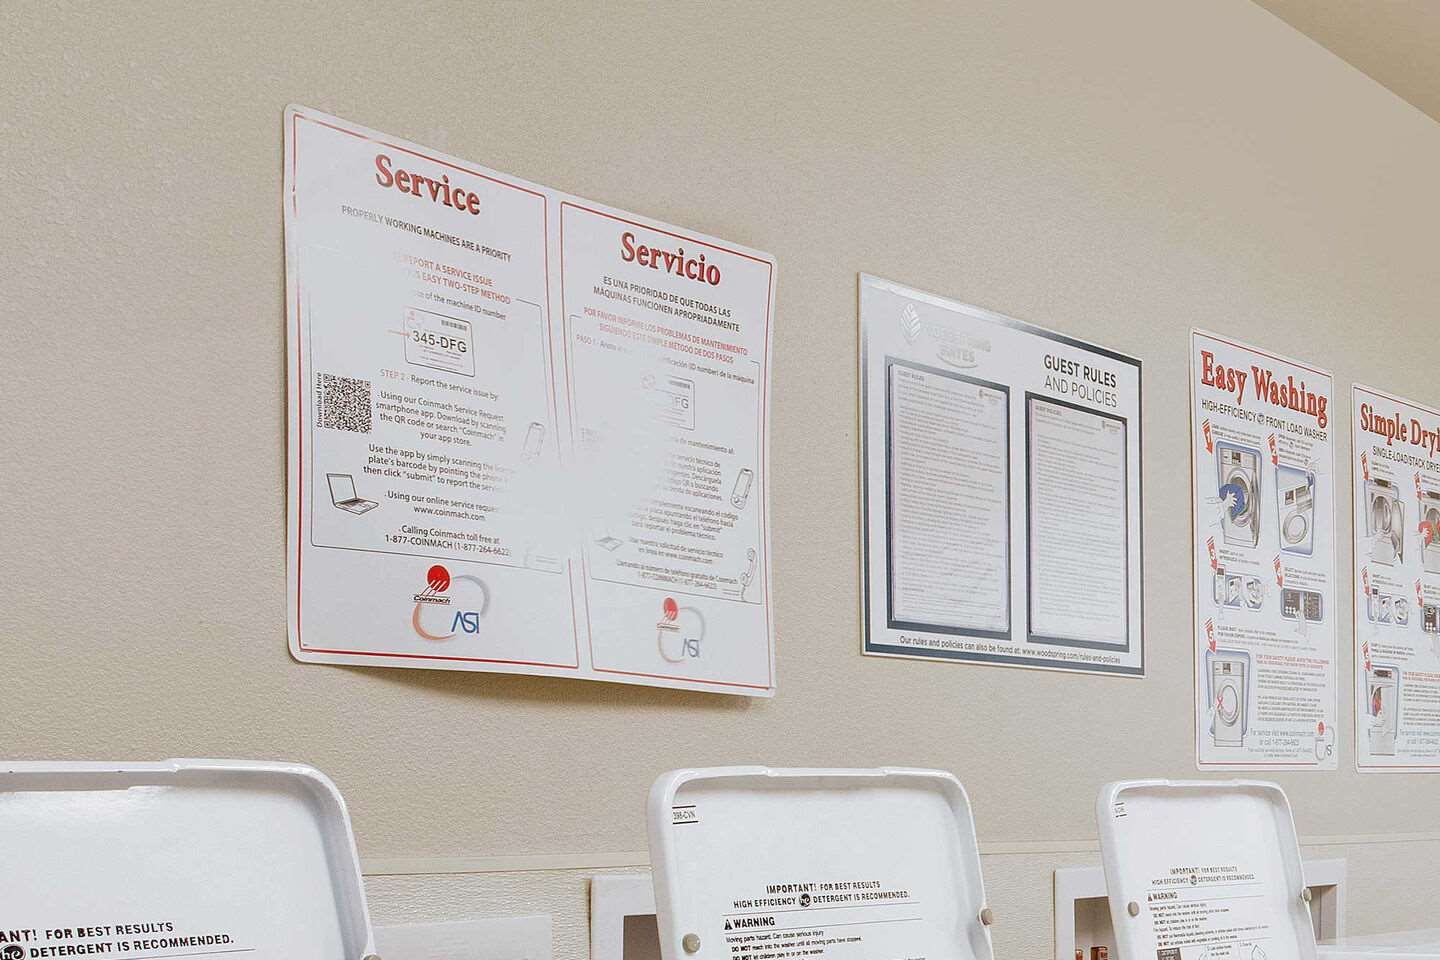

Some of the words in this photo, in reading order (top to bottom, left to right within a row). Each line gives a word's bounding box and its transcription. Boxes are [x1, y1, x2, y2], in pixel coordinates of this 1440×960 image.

[375, 154, 480, 215] Service
[342, 205, 383, 224] PROPERLY
[385, 217, 422, 235] WORKING
[423, 228, 460, 246] MACHINES
[461, 240, 474, 250] ARE
[481, 246, 511, 263] PRIORITY
[621, 232, 720, 286] Servicio
[435, 263, 441, 271] A
[442, 263, 472, 281] SERVICE
[473, 274, 493, 286] ISSUE
[422, 272, 441, 285] EASY
[443, 278, 479, 295] TWO-STEP
[481, 290, 511, 304] METHOD
[604, 276, 612, 284] ES
[613, 280, 628, 289] UNA
[630, 283, 668, 300] PRIORIDAD
[669, 295, 679, 303] DE
[680, 297, 694, 308] QUE
[695, 301, 717, 315] TODAS
[718, 308, 731, 317] LAS
[593, 286, 631, 304] MAQUINAS
[633, 297, 673, 315] FUNCIONEN
[674, 309, 740, 332] APROPRIADAMENTE
[412, 330, 467, 353] 345-DFG
[411, 375, 435, 386] Report
[1044, 354, 1080, 377] GUEST
[1084, 363, 1116, 388] RULES
[380, 391, 402, 403] Using
[418, 397, 452, 410] Coinmach
[1045, 375, 1068, 394] AND
[1071, 381, 1117, 408] POLICIES
[1201, 351, 1247, 405] Easy
[1251, 365, 1327, 429] Washing
[376, 402, 419, 416] smartphone
[1202, 400, 1257, 422] HIGH-EFFICIENCY
[1265, 416, 1285, 431] FRONT
[1287, 422, 1303, 435] LOAD
[1304, 426, 1327, 441] WASHER
[1361, 403, 1407, 445] Simple
[369, 444, 384, 453] Use
[364, 466, 382, 475] then
[384, 469, 400, 477] click
[369, 455, 394, 466] plate's
[396, 460, 427, 471] barcode
[439, 467, 469, 479] pointing
[388, 490, 409, 502] Using
[426, 496, 449, 505] online
[414, 506, 485, 521] www.coinmach.com
[385, 534, 452, 549] 1-877-COINMACH
[402, 525, 428, 537] Calling
[430, 529, 465, 540] Coinmach
[452, 611, 479, 634] ASI
[900, 636, 911, 644] Our
[913, 638, 927, 646] rules
[929, 639, 940, 648] and
[942, 640, 963, 650] policies
[965, 642, 975, 650] can
[976, 643, 988, 652] also
[997, 644, 1014, 654] found
[766, 883, 817, 894] IMPORTANT!
[820, 883, 833, 891] FOR
[835, 882, 851, 890] BEST
[853, 881, 880, 889] RESULTS
[734, 900, 753, 908] HIGH
[755, 897, 796, 907] EFFICIENCY
[813, 894, 852, 903] DETERGENT
[861, 891, 909, 900] RECOMMENDED.
[46, 929, 72, 940] FOR
[78, 926, 111, 937] BEST
[116, 922, 173, 935] RESULTS
[733, 917, 775, 928] WARNING
[31, 943, 112, 957] DETERGENT
[118, 942, 129, 951] IS
[134, 934, 234, 950] RECOMMENDED.
